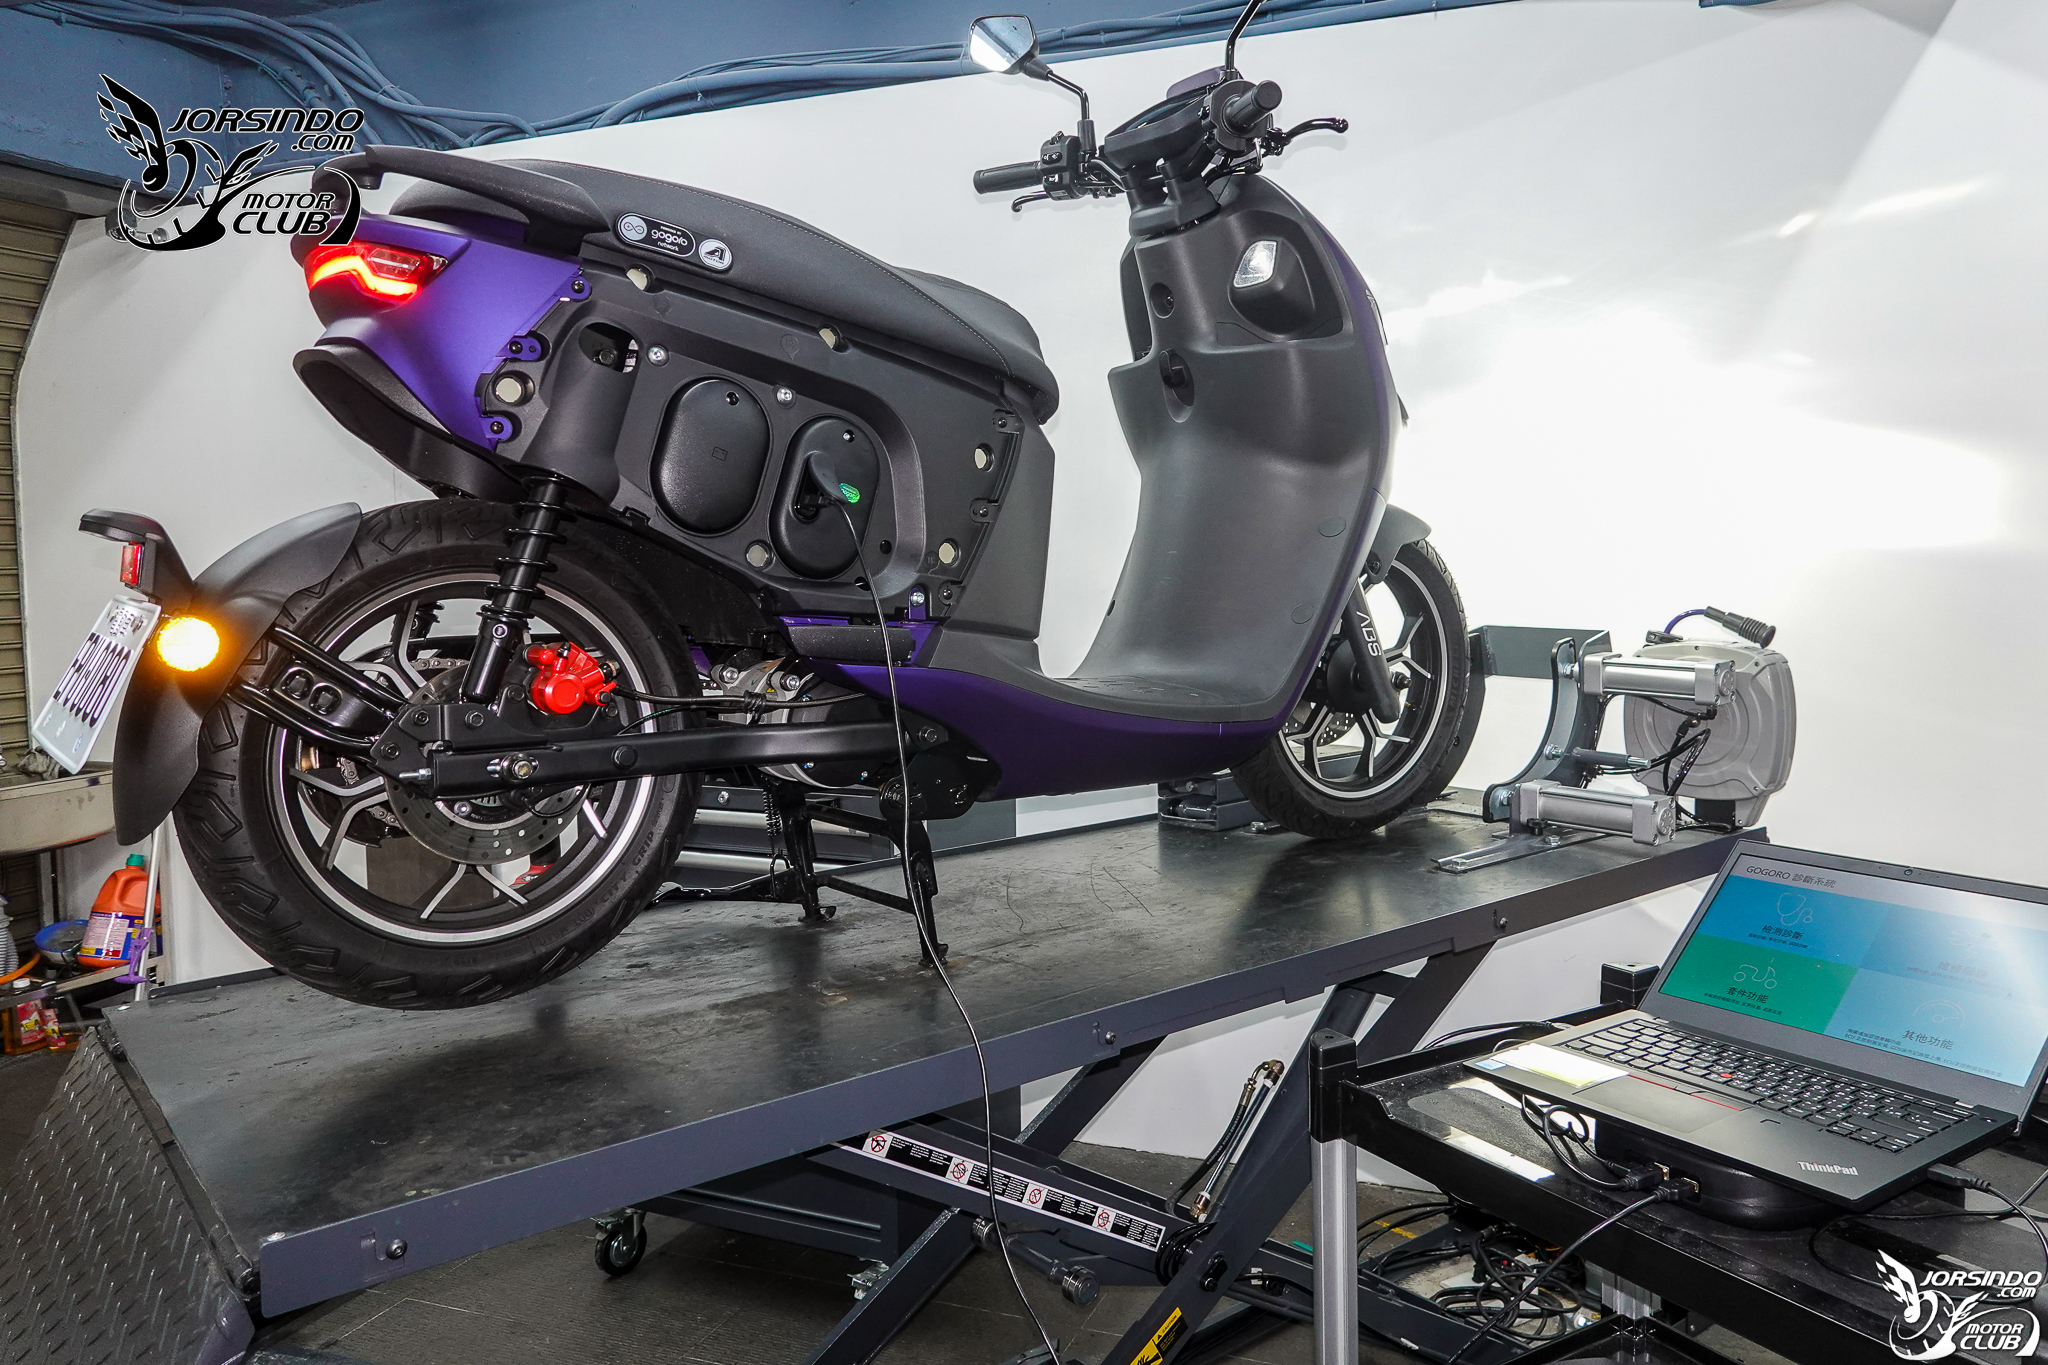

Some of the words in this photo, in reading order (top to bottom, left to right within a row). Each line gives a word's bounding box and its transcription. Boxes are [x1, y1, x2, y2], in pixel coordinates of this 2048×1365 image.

[651, 229, 688, 246] gogoro
[1356, 611, 1382, 656] ABS
[633, 831, 654, 866] GRIP
[1746, 866, 1790, 879] GOGORO
[1726, 986, 1769, 1004] 套件功能
[1902, 1029, 1954, 1050] 其他功能
[1797, 1161, 1858, 1176] ThinkPad
